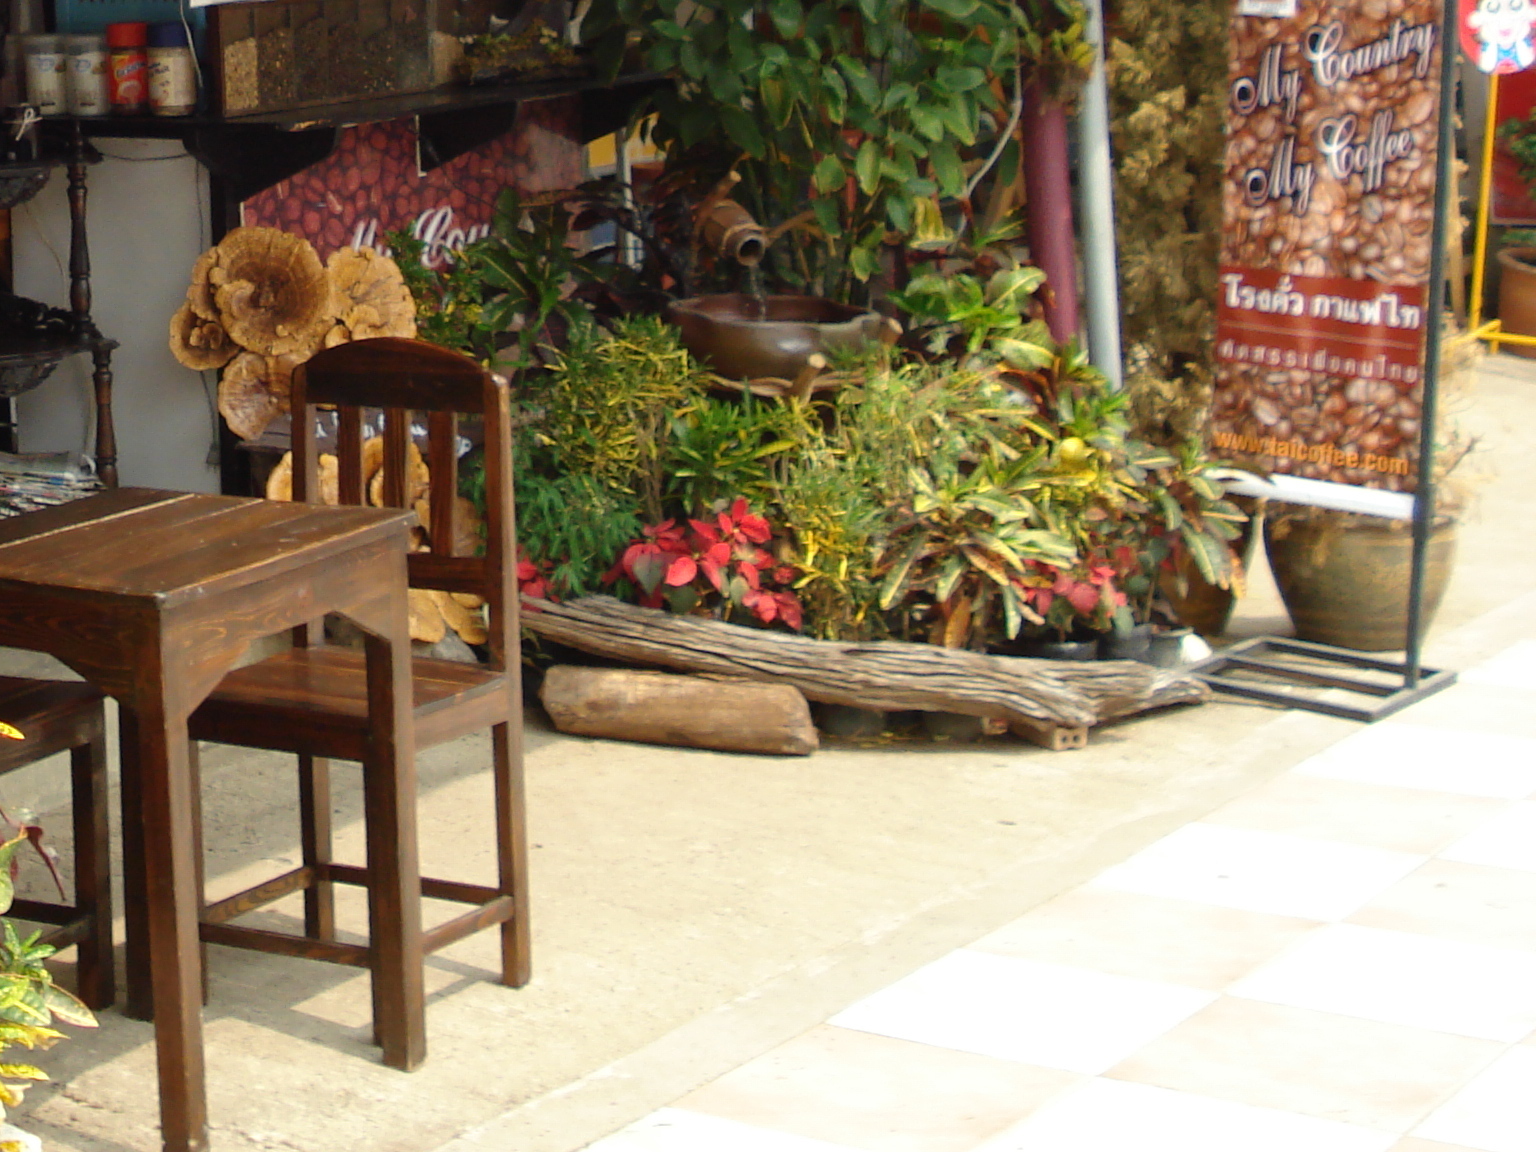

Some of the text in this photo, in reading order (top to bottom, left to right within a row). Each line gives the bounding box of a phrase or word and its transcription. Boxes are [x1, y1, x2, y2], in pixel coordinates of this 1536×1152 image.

[1231, 18, 1436, 124] My Country
[1244, 107, 1414, 216] My Coffee
